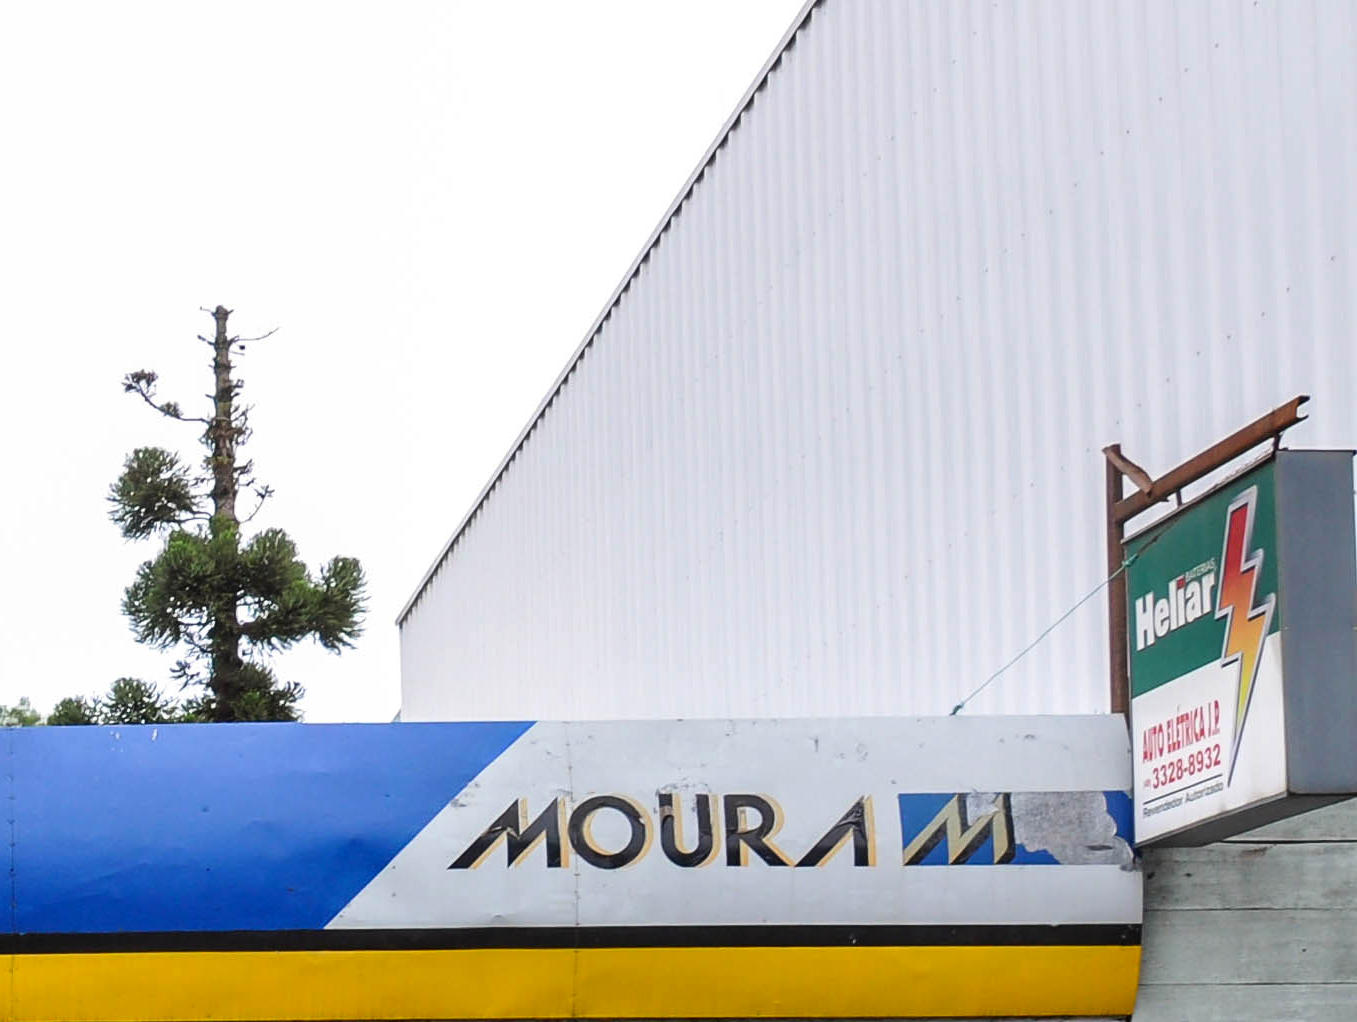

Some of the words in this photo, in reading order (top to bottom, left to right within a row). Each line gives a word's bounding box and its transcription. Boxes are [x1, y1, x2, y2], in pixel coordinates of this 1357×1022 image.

[1136, 573, 1216, 651] Heliar
[1143, 723, 1164, 763] AUTO
[1153, 743, 1221, 789] 3328-8932
[447, 791, 878, 870] MOURA
